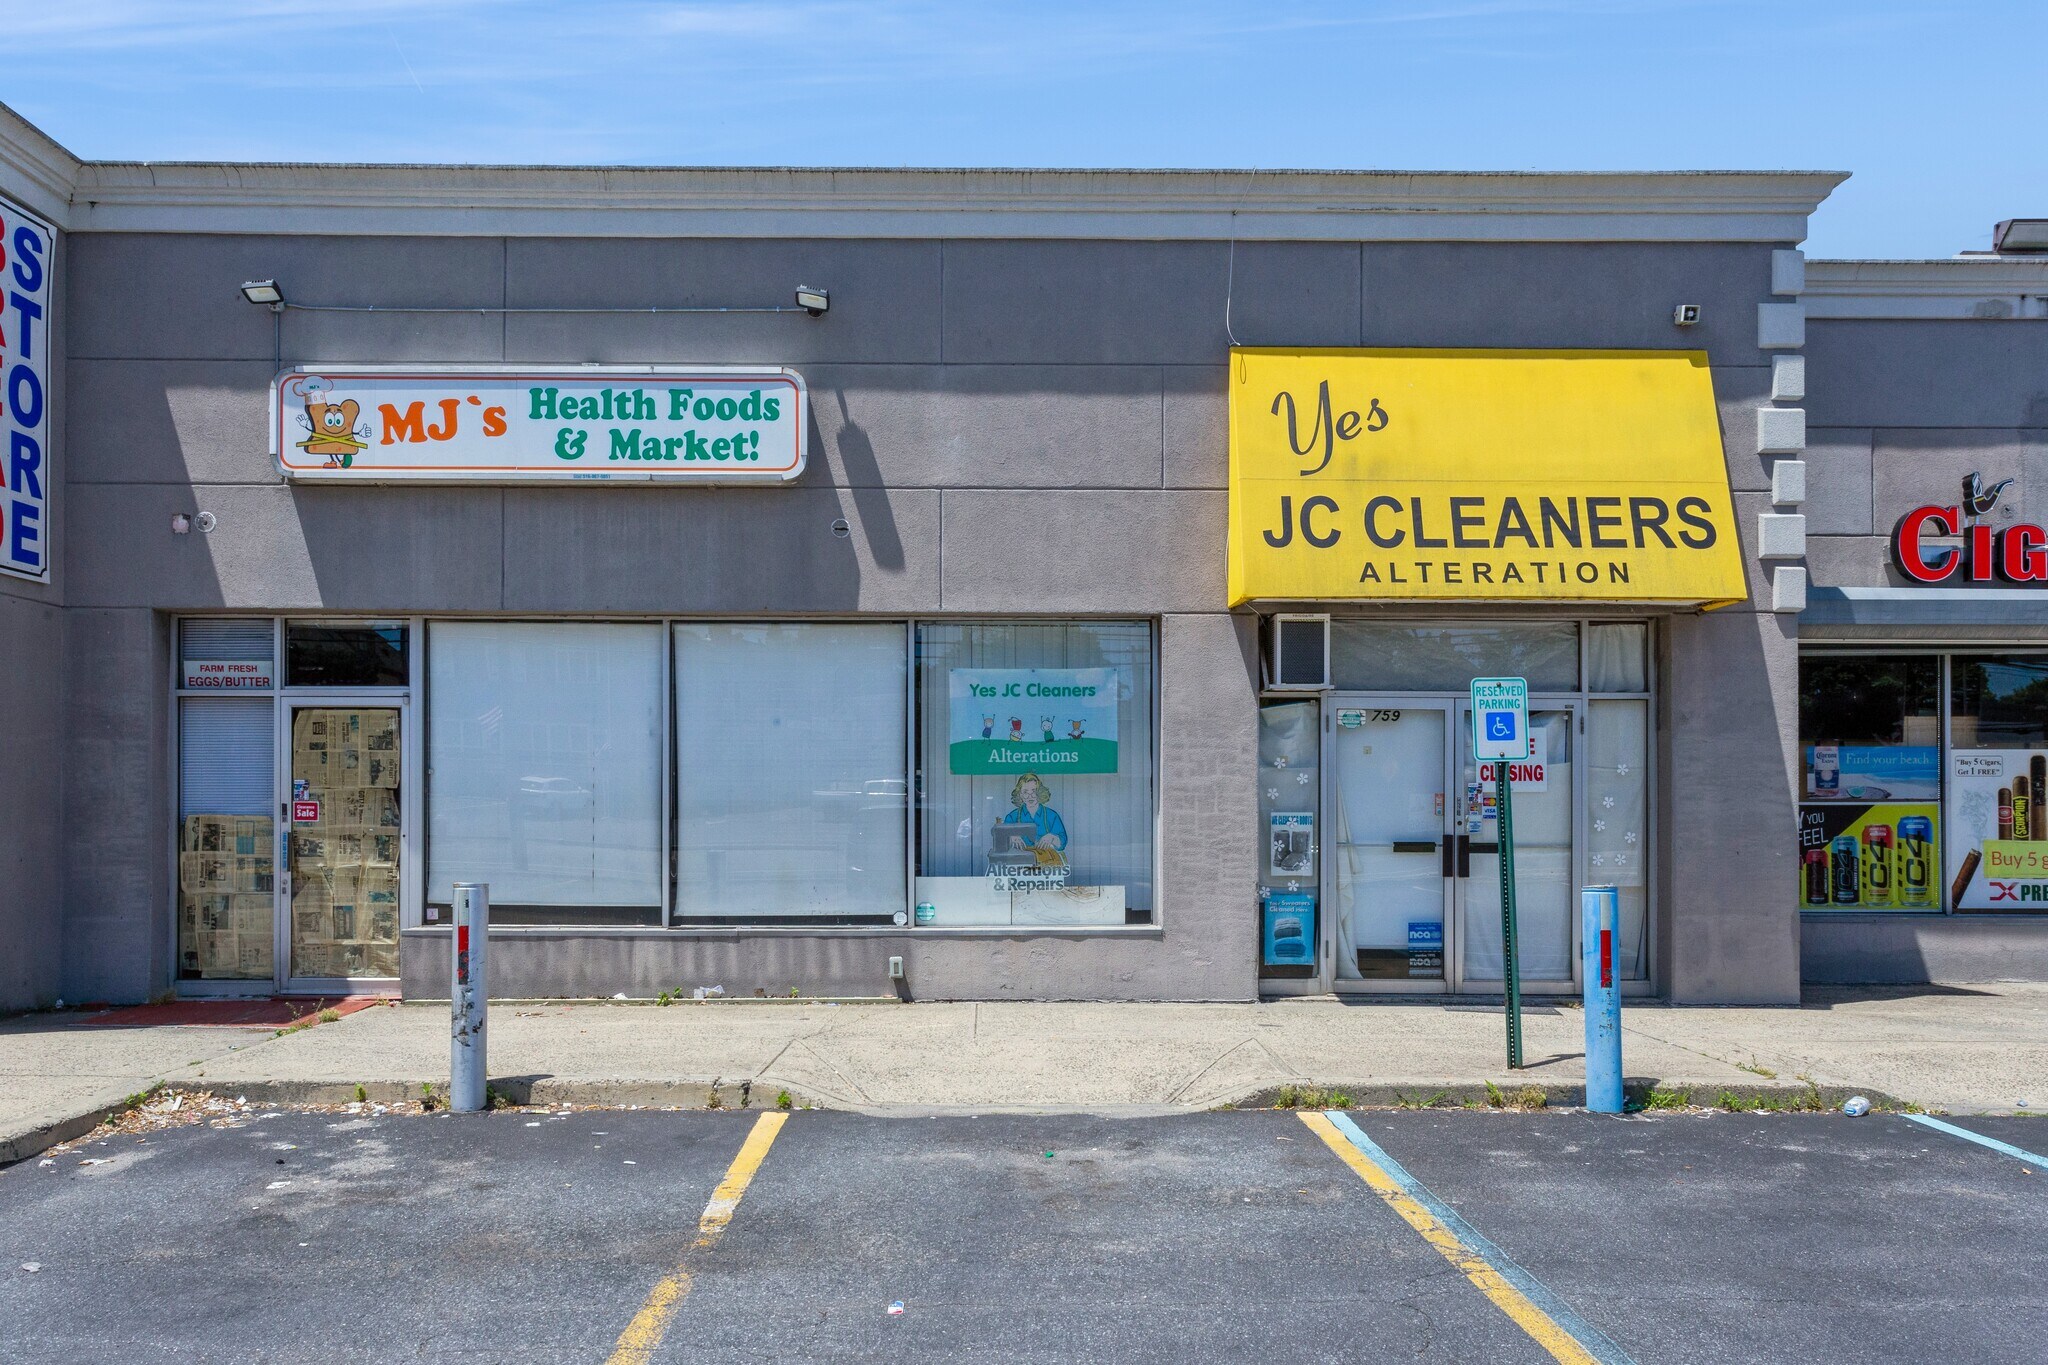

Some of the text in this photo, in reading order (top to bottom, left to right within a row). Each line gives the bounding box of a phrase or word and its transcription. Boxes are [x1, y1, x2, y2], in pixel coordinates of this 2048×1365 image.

[8, 226, 43, 567] STORE
[528, 387, 781, 422] Health Foods
[1270, 379, 1389, 477] Yes
[554, 428, 760, 461] & Market!
[1262, 495, 1718, 550] JC CLEANERS
[1359, 562, 1631, 583] ALTERATION
[200, 664, 258, 673] FARM FRESH
[188, 675, 270, 688] EGGS/BUTTER
[969, 683, 1096, 698] Yes JC Cleaners
[1476, 685, 1523, 697] RESERVED
[1479, 698, 1521, 710] PARKING
[1371, 710, 1401, 722] 759
[988, 747, 1079, 763] Alterations
[1816, 751, 1837, 760] Corona
[1846, 752, 1870, 764] Find
[1873, 756, 1897, 768] your
[1973, 757, 1979, 766] 5
[1480, 764, 1544, 782] CLSING
[296, 809, 315, 817] Sale
[1806, 812, 1825, 825] YOU
[2015, 798, 2027, 836] SCORPION
[1869, 838, 1888, 889] C4
[1906, 830, 1926, 887] C4
[1991, 851, 2023, 870] Buy
[2027, 851, 2037, 867] 5
[985, 863, 1071, 877] Alterations
[993, 876, 1065, 895] & Repairs
